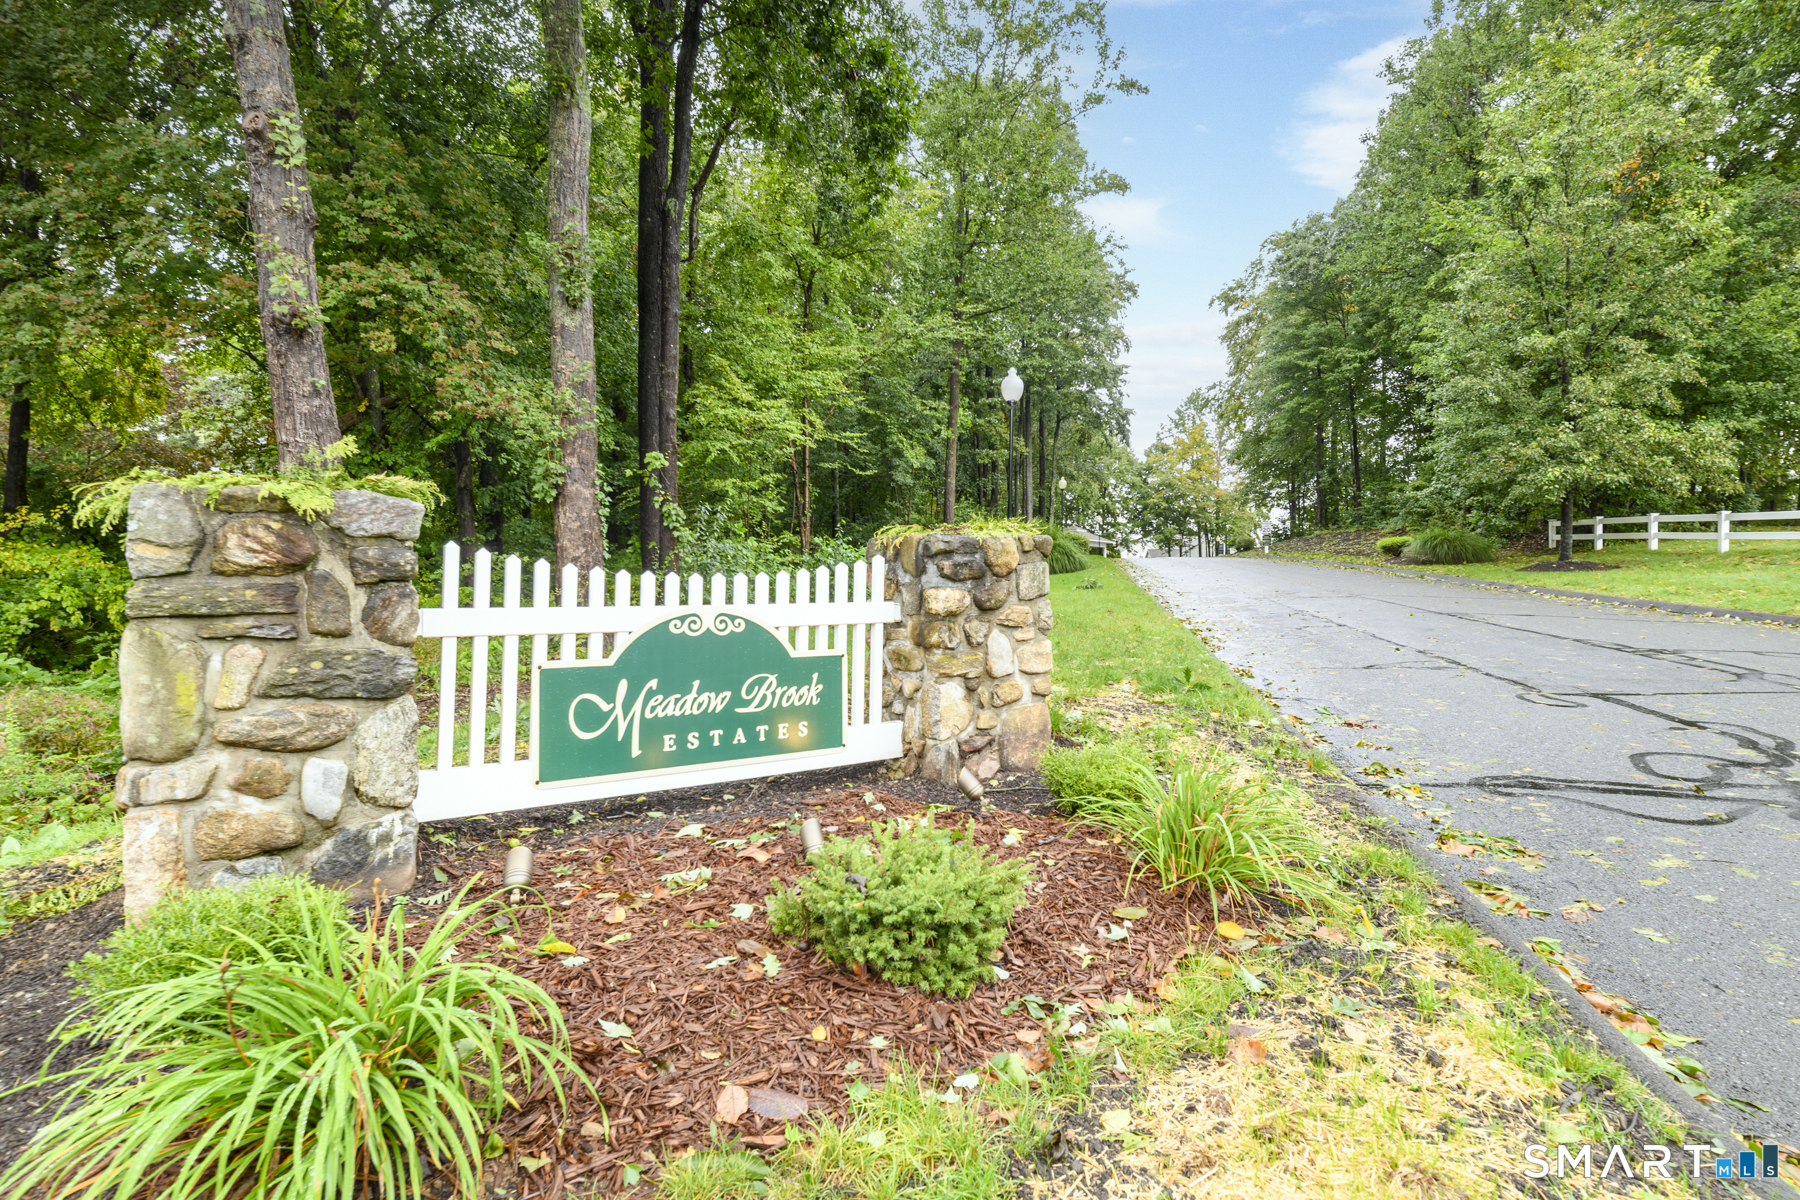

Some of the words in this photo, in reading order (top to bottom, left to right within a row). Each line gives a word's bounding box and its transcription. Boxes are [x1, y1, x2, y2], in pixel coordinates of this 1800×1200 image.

[568, 678, 732, 758] Meadow
[734, 673, 823, 713] Brook
[662, 721, 809, 752] ESTATES
